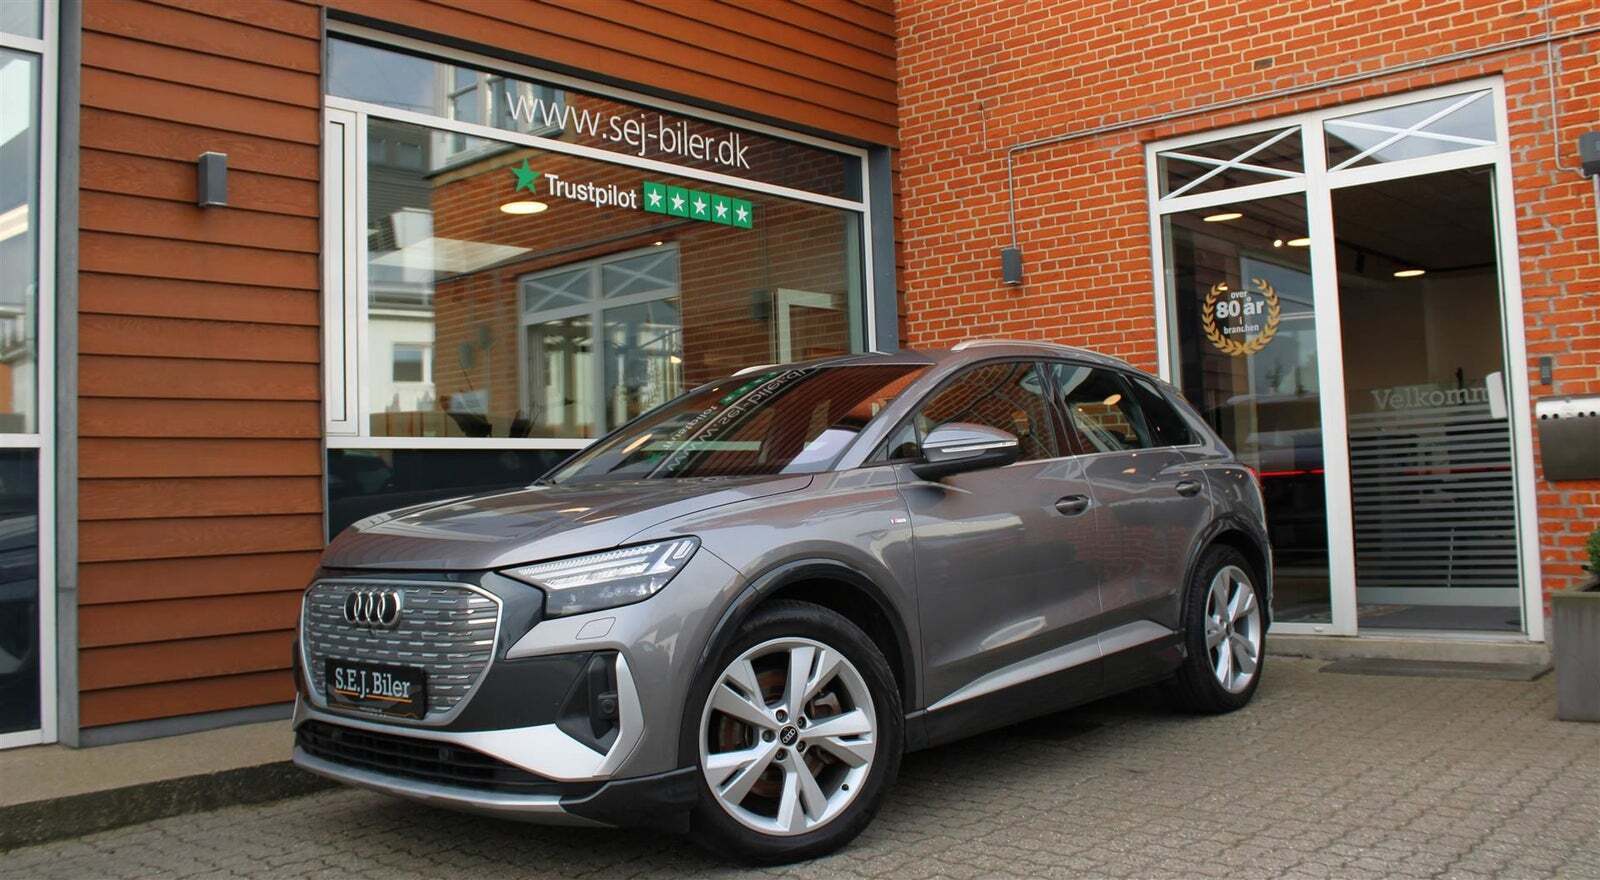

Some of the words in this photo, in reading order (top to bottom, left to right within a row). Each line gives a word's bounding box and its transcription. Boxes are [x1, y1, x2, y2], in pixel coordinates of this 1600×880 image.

[506, 91, 751, 169] www.sej-biler.dk
[544, 173, 637, 211] Trustpilot
[1216, 300, 1240, 319] 80
[1243, 296, 1265, 315] år
[1230, 291, 1248, 299] over
[1223, 323, 1260, 335] branchen
[1371, 386, 1489, 411] Velkomm
[335, 667, 370, 699] S.E.J.
[372, 671, 411, 698] Biler
